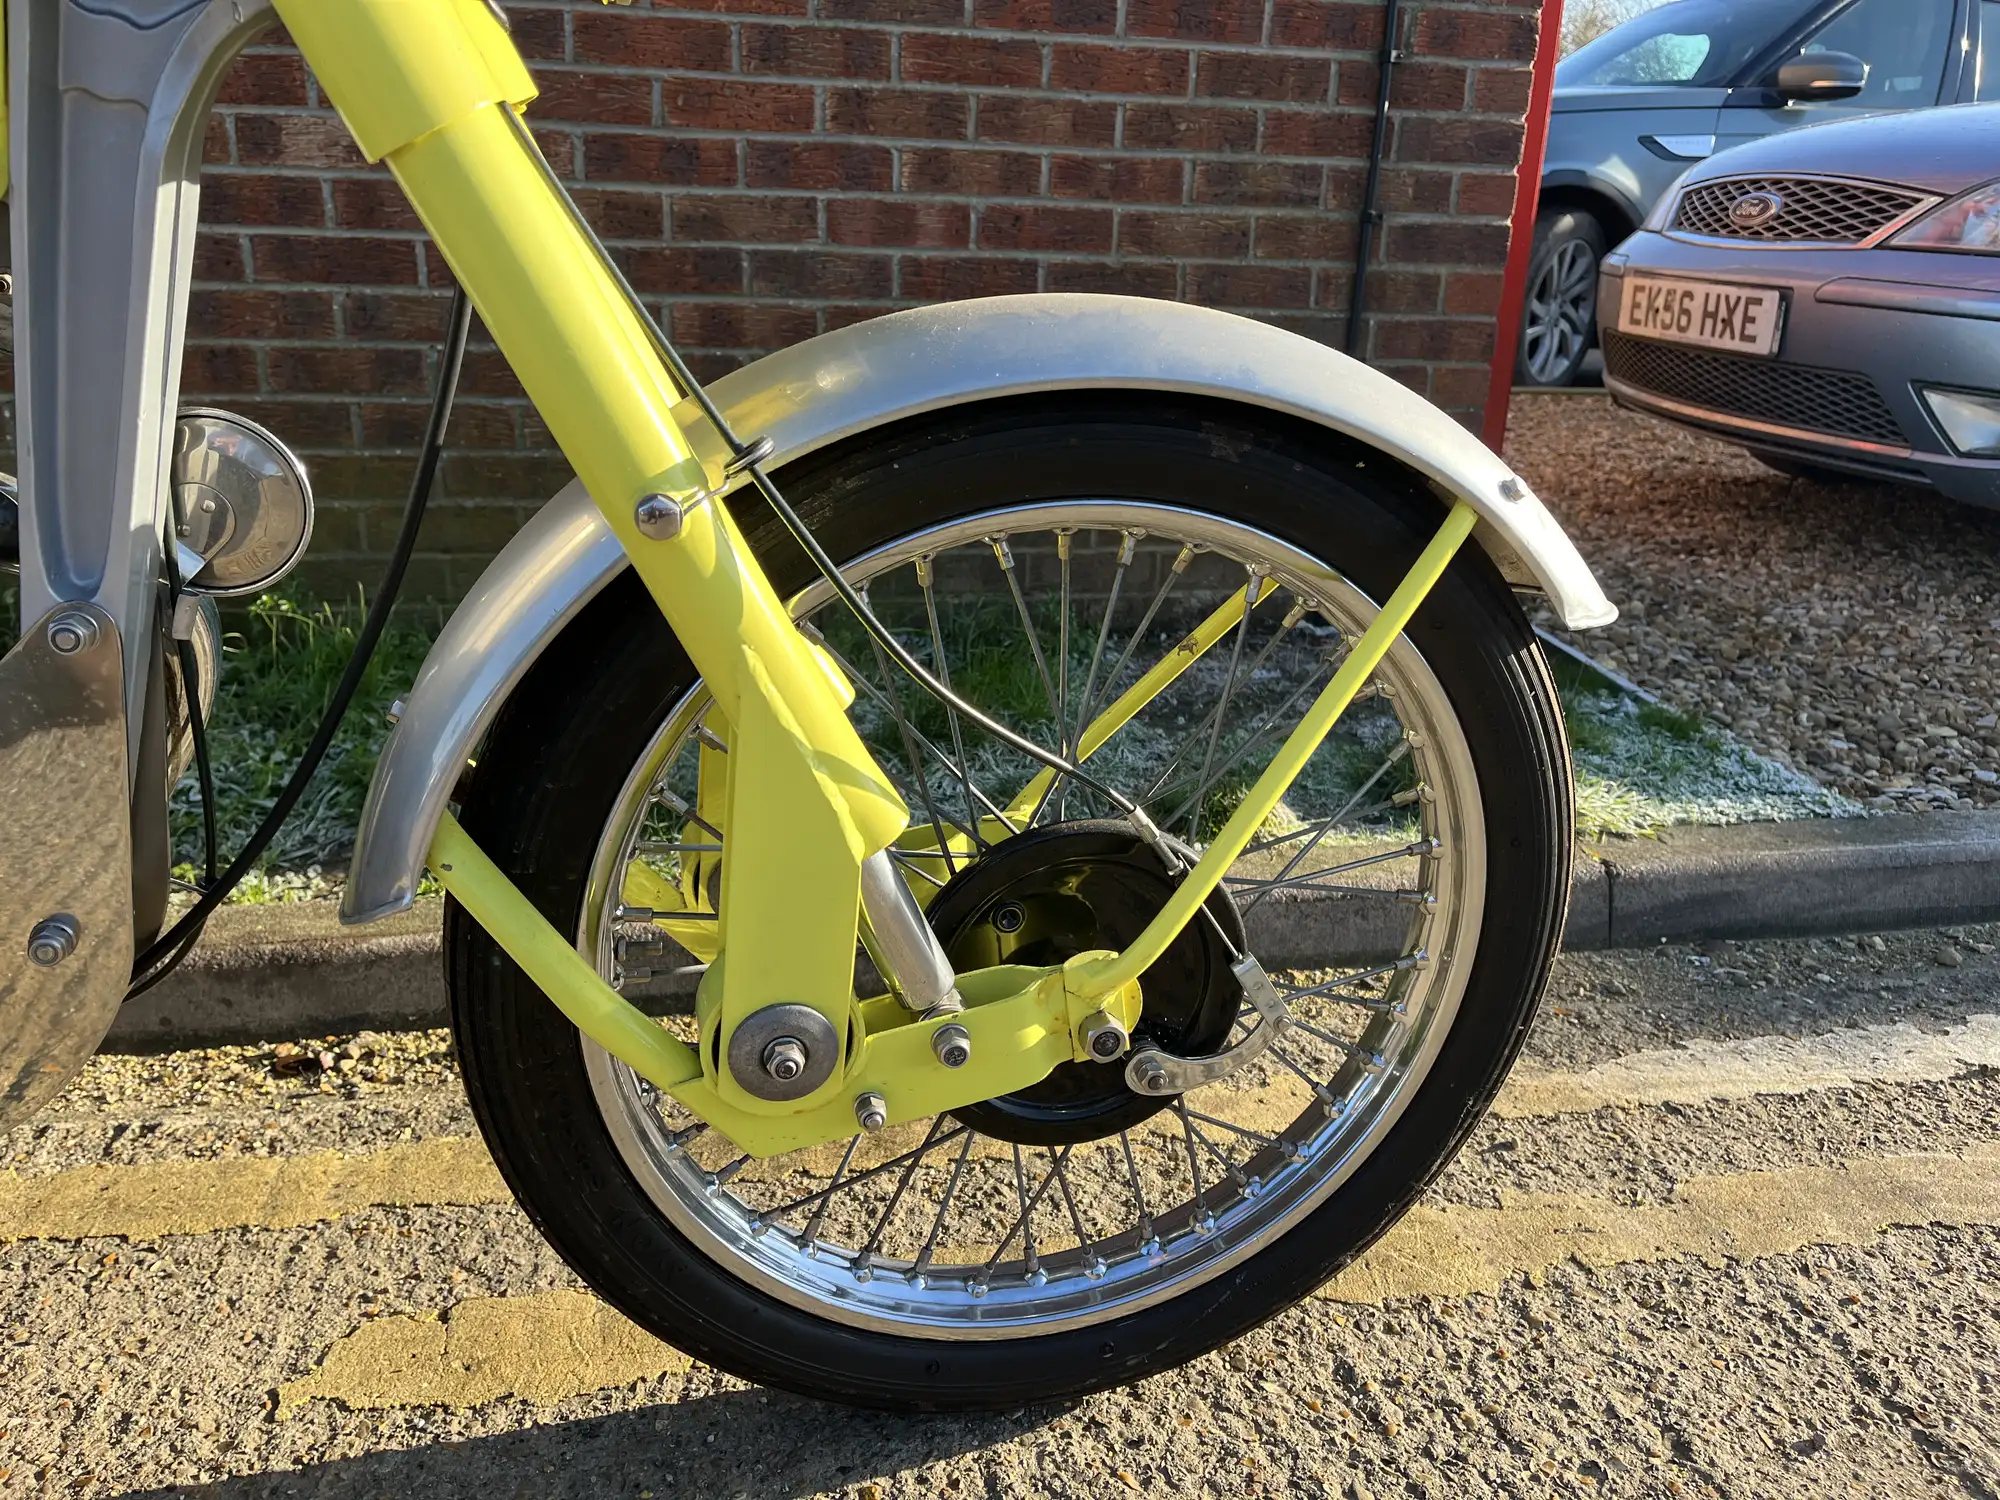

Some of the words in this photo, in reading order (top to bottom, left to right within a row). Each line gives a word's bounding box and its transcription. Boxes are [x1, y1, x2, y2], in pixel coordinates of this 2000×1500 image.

[1735, 198, 1765, 216] Ford
[1628, 284, 1695, 334] EK56
[1699, 291, 1764, 344] HXE
